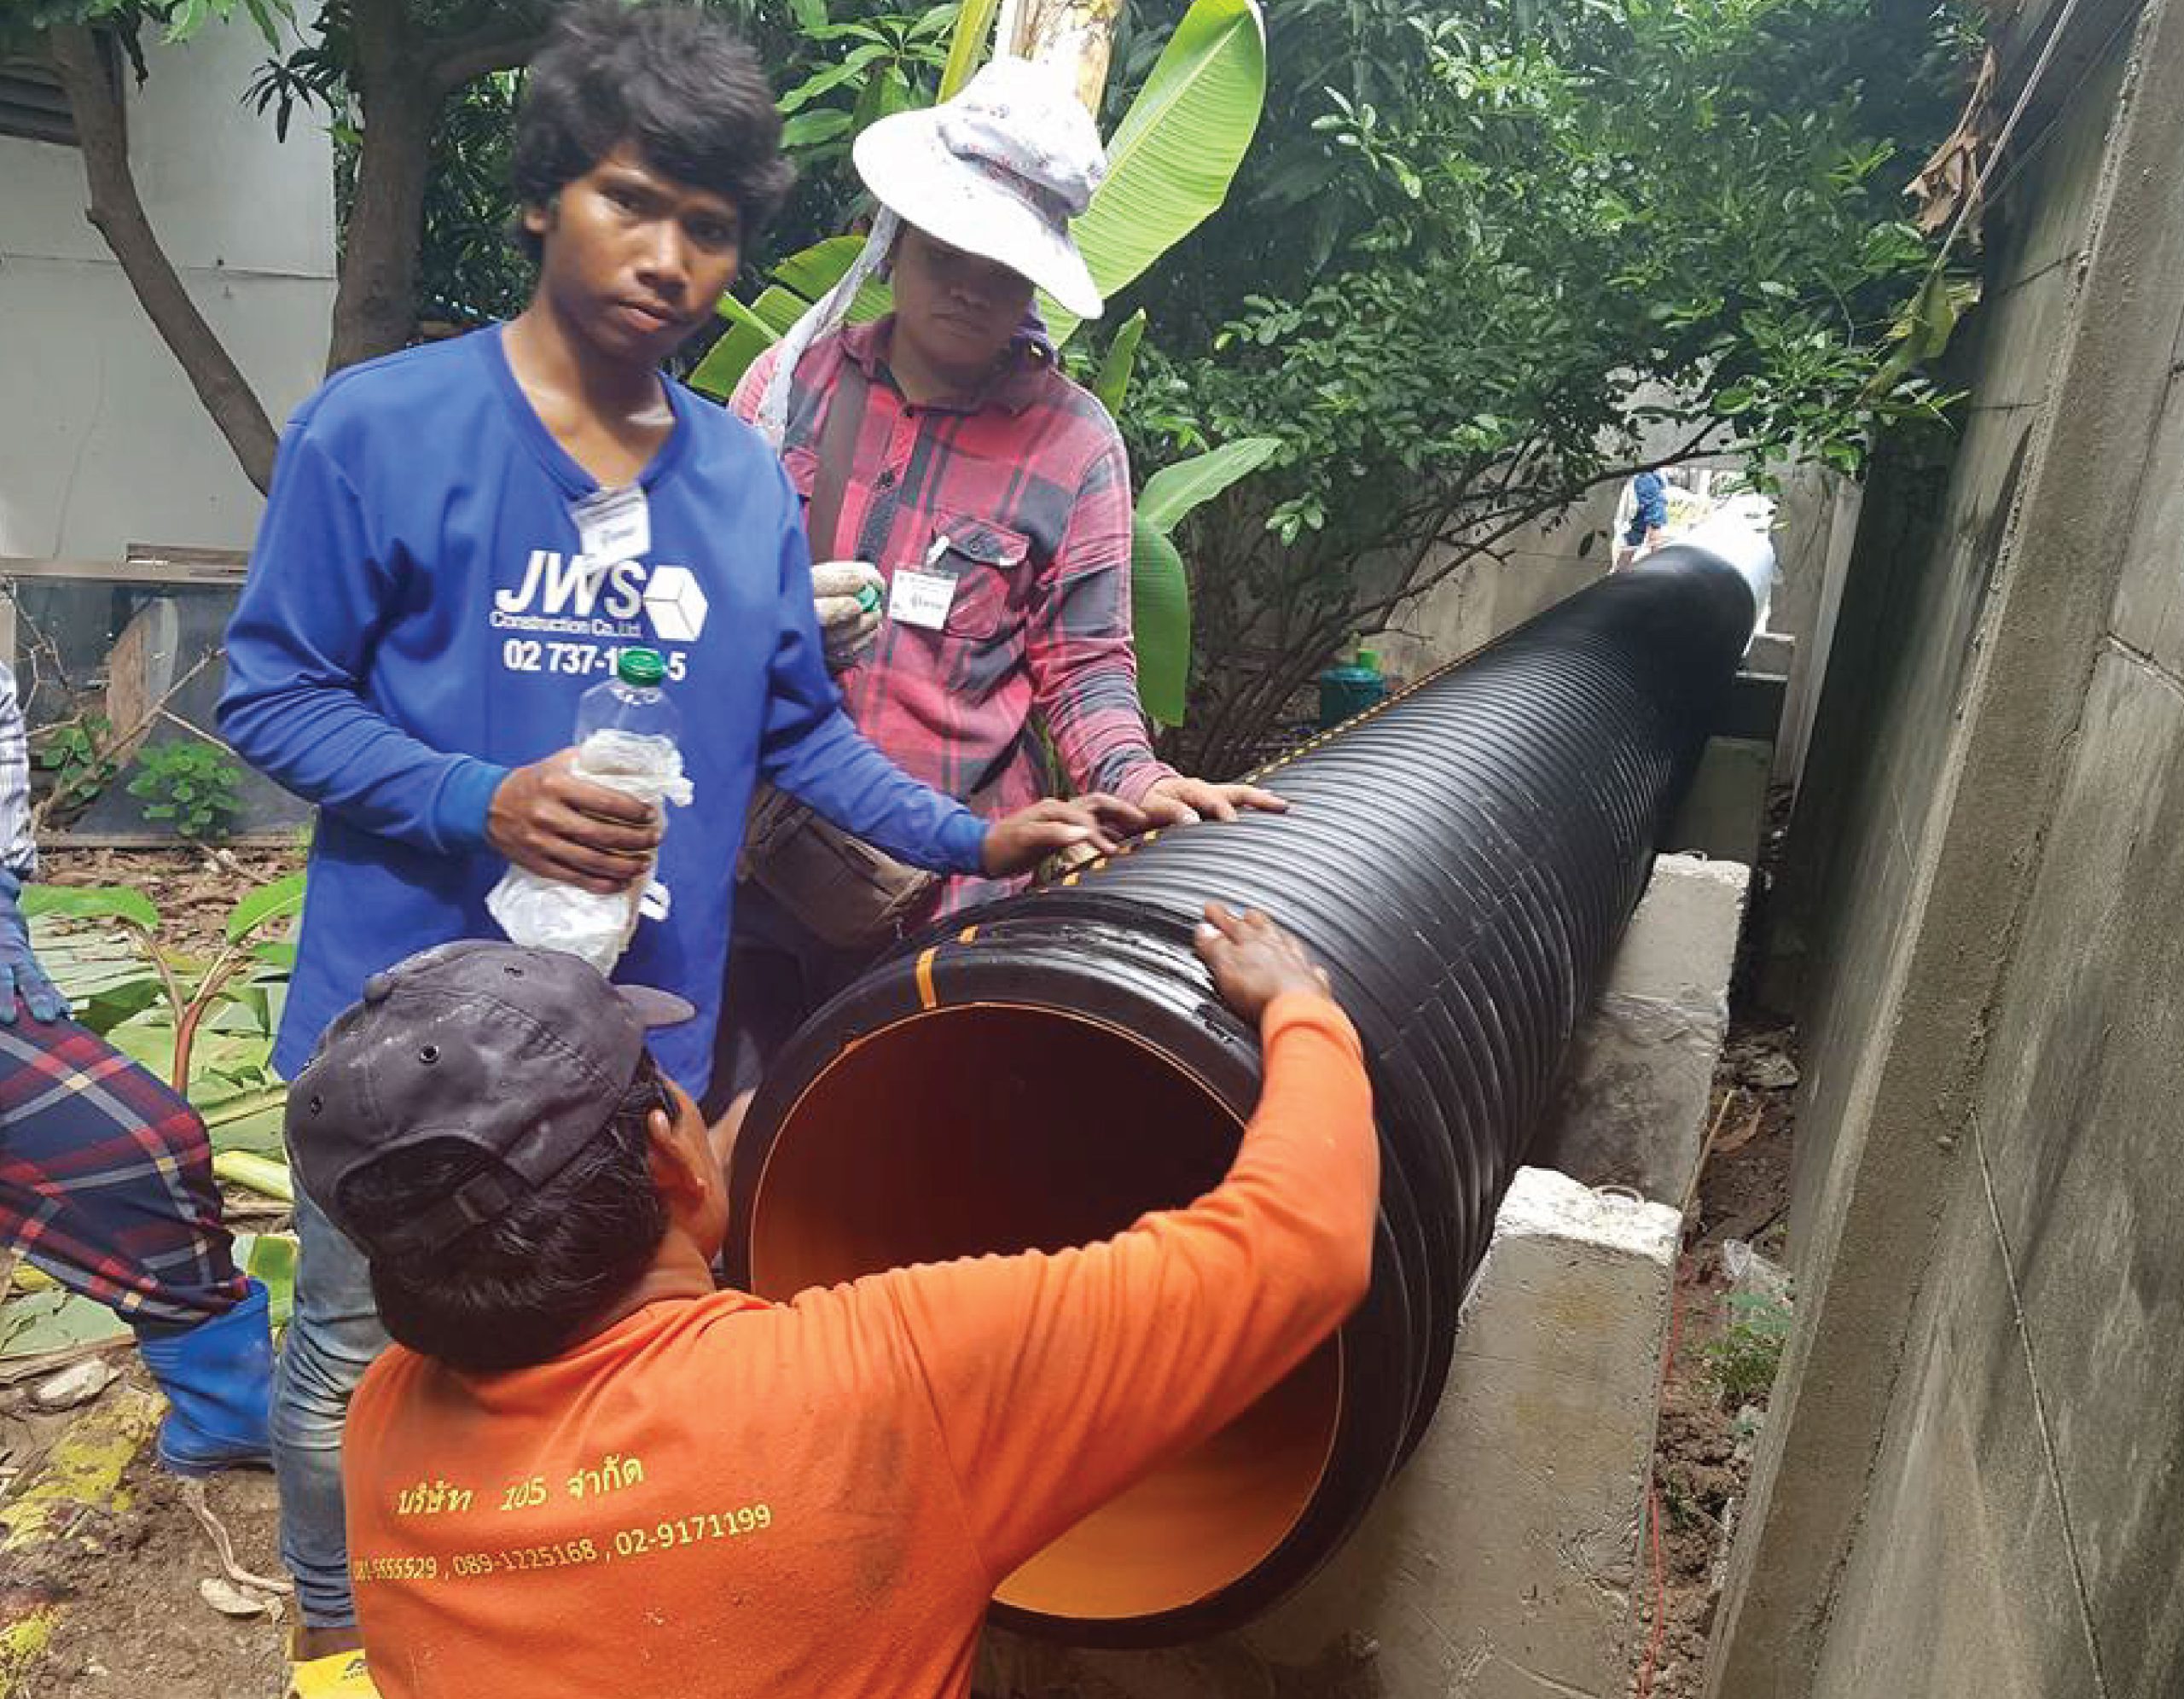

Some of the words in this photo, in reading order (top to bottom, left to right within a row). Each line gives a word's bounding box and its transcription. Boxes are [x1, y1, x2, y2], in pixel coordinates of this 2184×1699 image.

[494, 550, 647, 620] JWS
[503, 638, 542, 672] 02
[616, 1504, 772, 1555] 02-9171199
